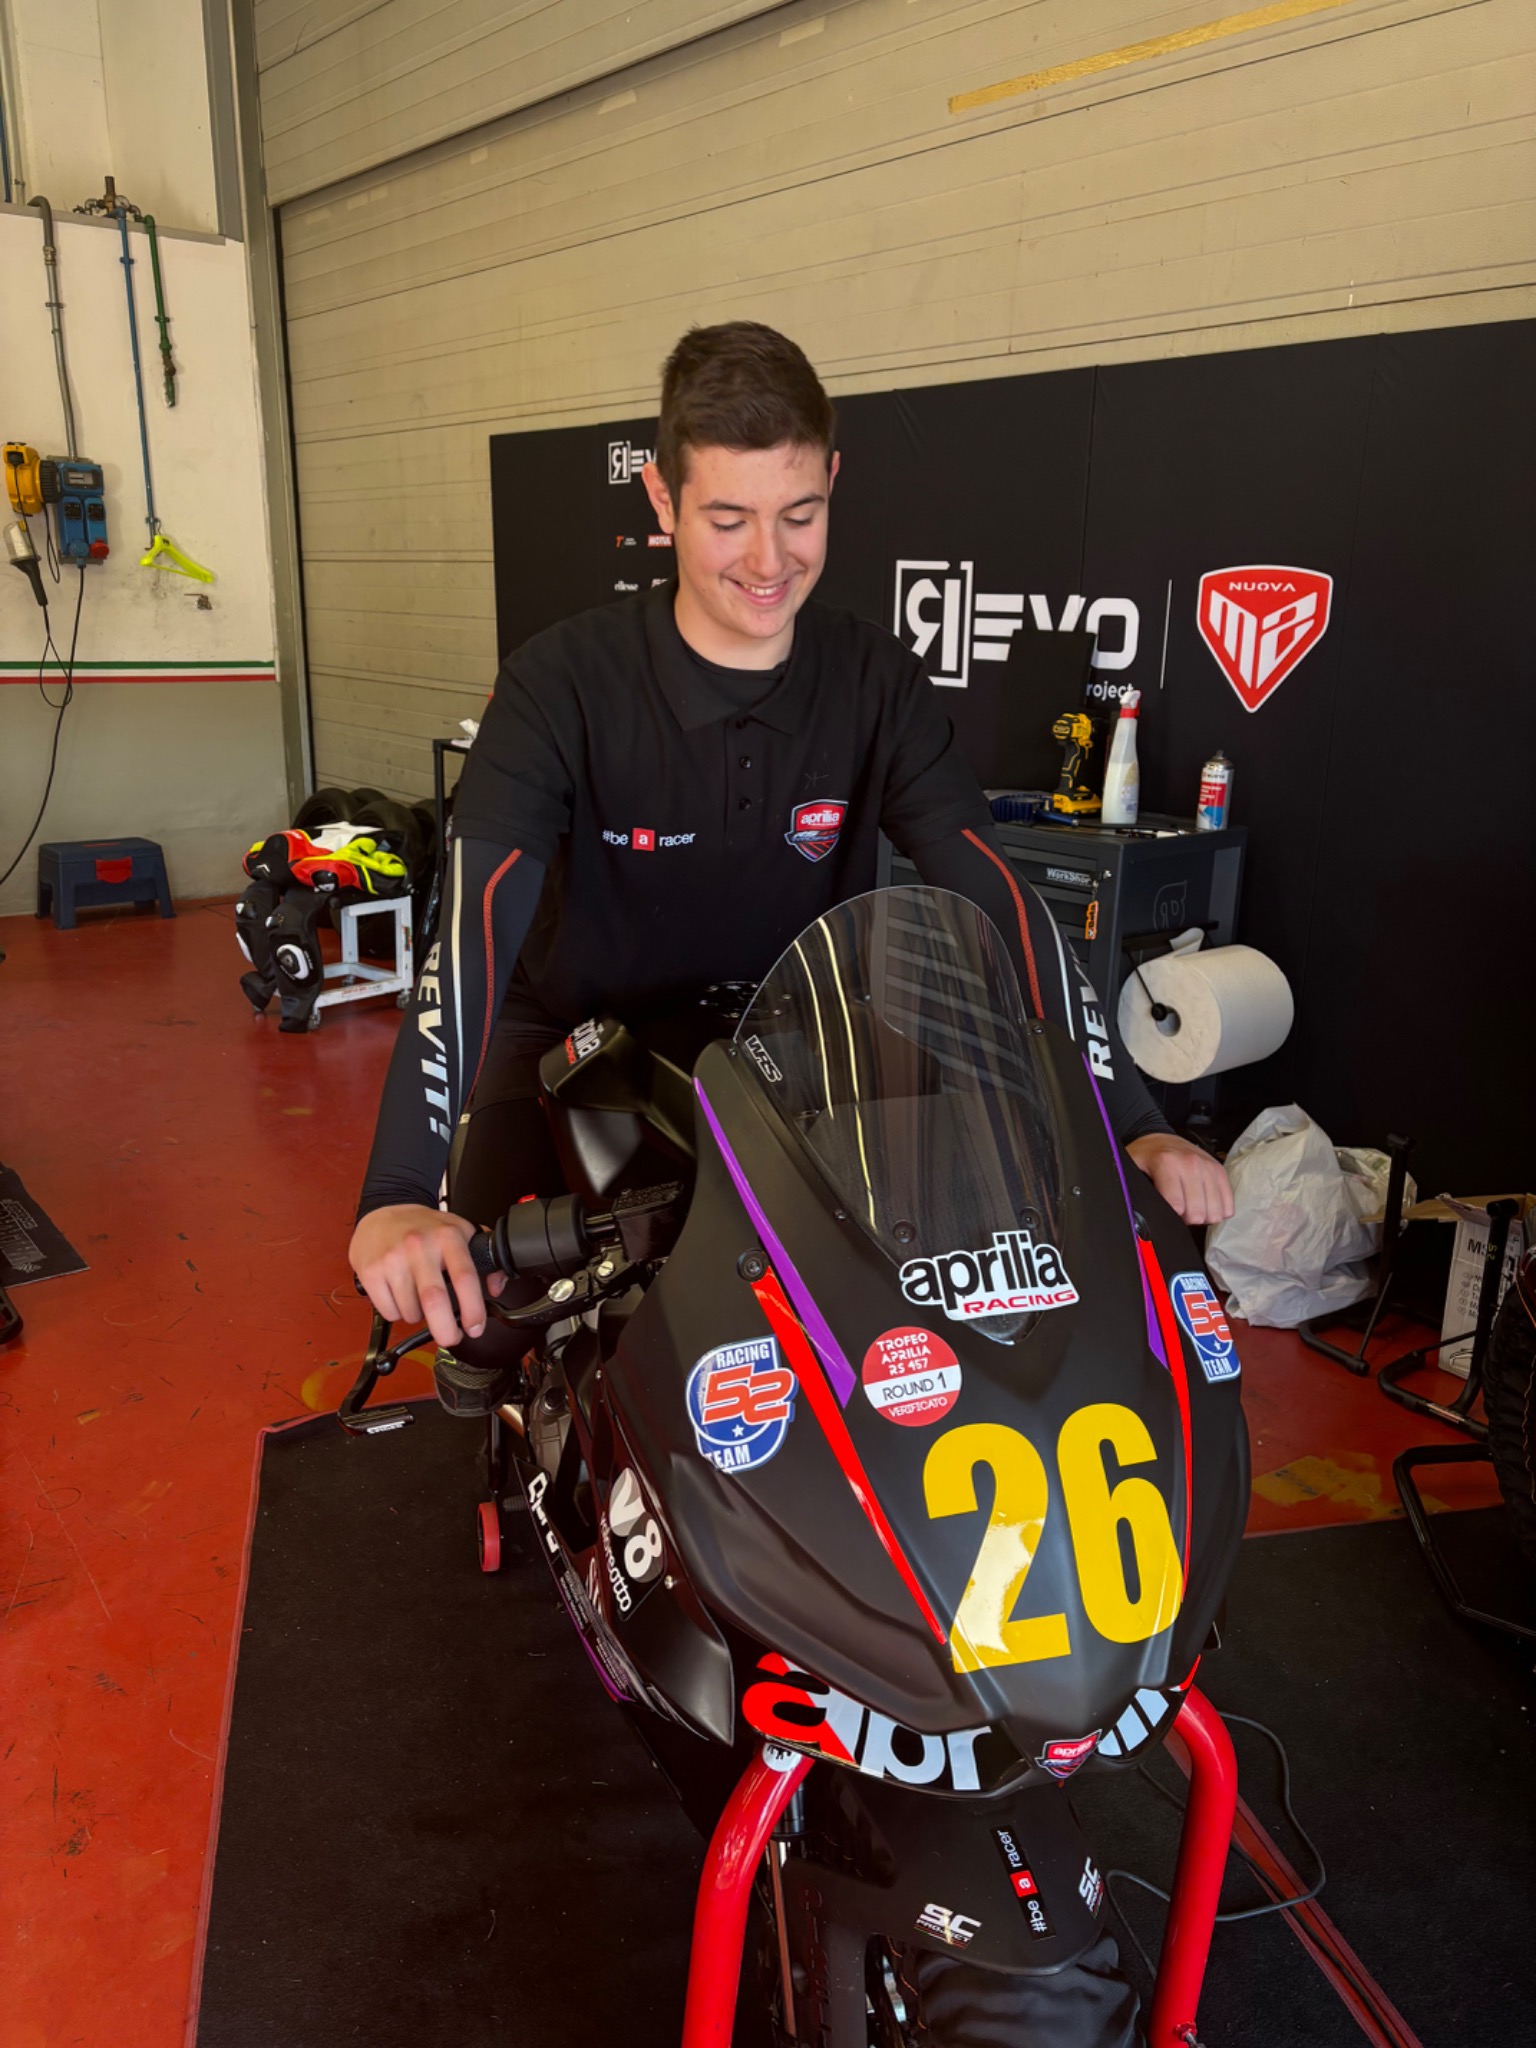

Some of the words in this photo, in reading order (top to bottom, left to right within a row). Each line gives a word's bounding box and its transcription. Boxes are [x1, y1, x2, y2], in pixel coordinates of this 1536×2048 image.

[1229, 581, 1296, 593] NUOVA
[1086, 680, 1134, 701] roject
[801, 809, 840, 825] aprilia
[602, 830, 629, 846] #be
[638, 834, 648, 845] a
[659, 831, 696, 848] racer
[901, 1231, 1069, 1311] aprilia
[964, 1289, 1077, 1315] RACING
[876, 1332, 928, 1352] TROFEO
[716, 1343, 770, 1369] RACING
[881, 1345, 932, 1365] APRILIA
[888, 1363, 905, 1376] RS
[908, 1357, 928, 1371] 457
[1204, 1358, 1233, 1376] TEAM
[702, 1363, 794, 1425] 52
[882, 1379, 934, 1401] ROUND
[937, 1371, 947, 1389] 1
[888, 1397, 947, 1417] VERIFICATO
[703, 1444, 751, 1469] TEAM
[923, 1403, 1183, 1673] 26
[997, 1830, 1023, 1868] racer
[919, 1903, 982, 1938] SC
[1027, 1900, 1048, 1933] #be
